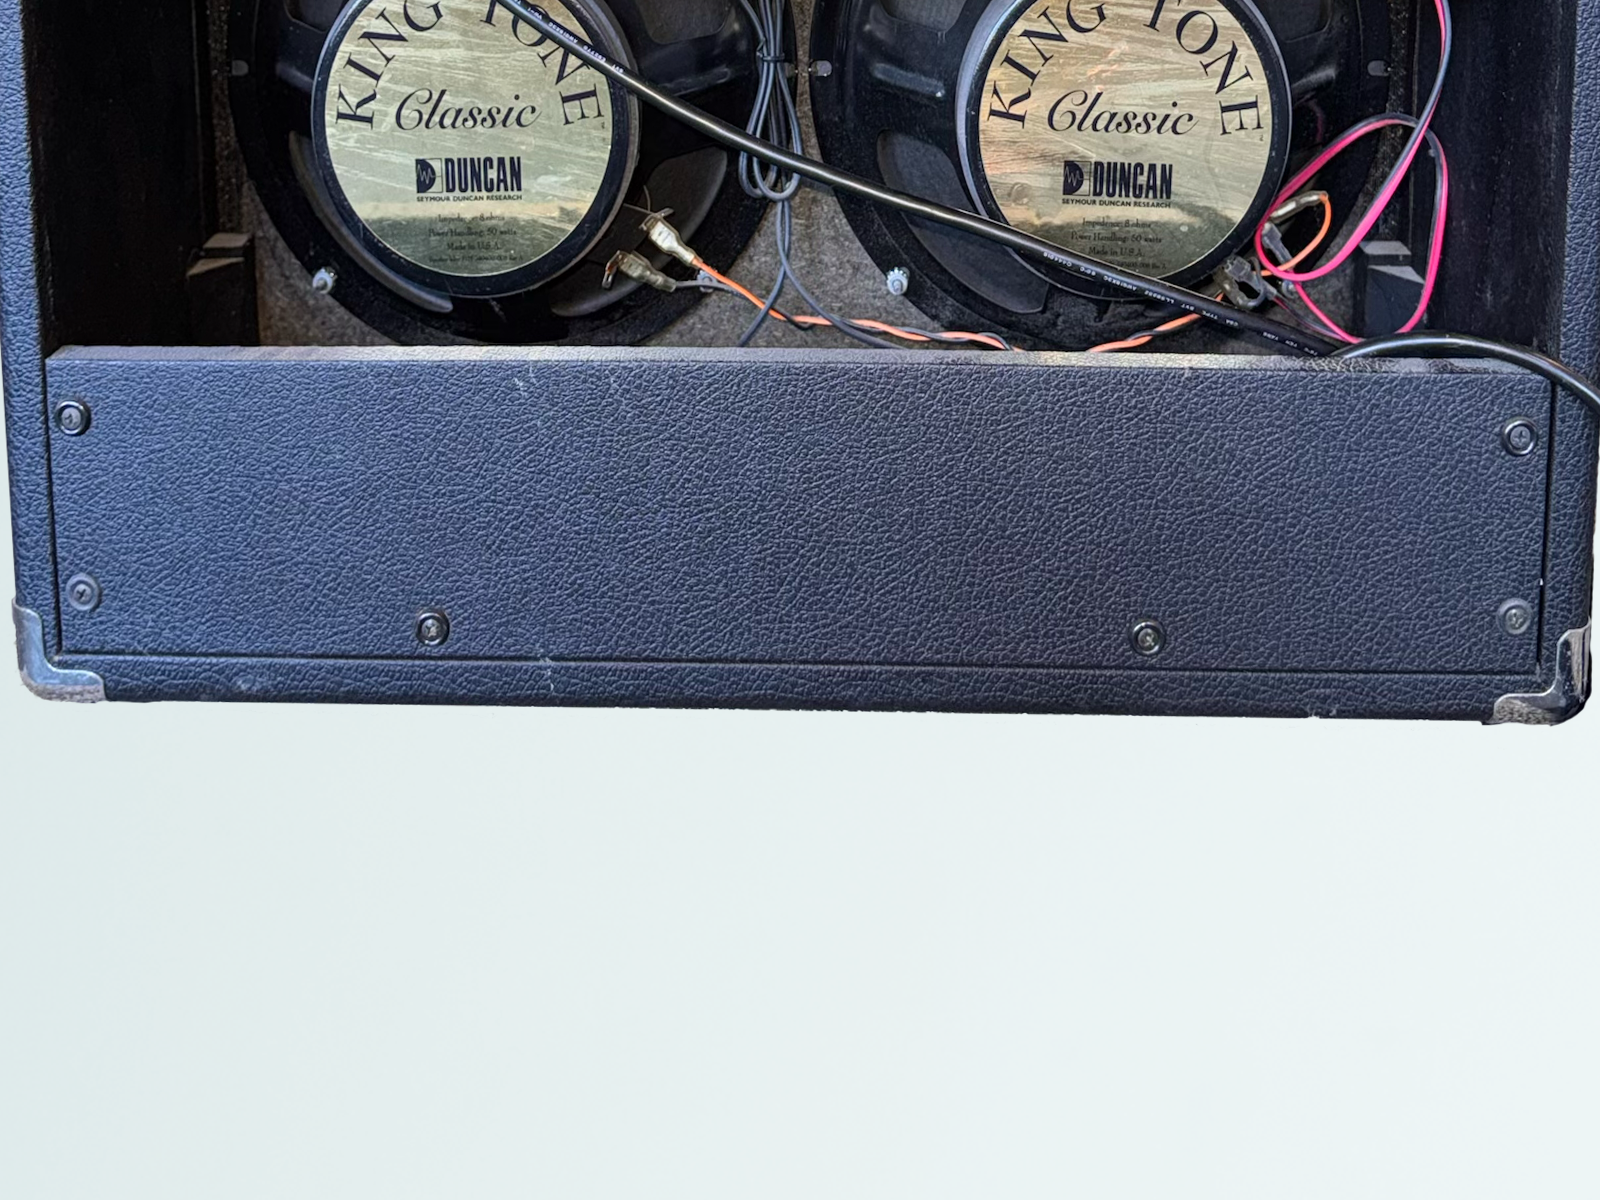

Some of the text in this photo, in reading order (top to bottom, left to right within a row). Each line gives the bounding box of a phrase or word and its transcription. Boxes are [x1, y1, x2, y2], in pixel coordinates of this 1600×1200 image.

[395, 88, 542, 131] Classic
[1047, 89, 1198, 135] Classic
[444, 156, 522, 193] DUNCAN
[1092, 161, 1173, 199] DUNCAN
[1062, 198, 1096, 206] SEYMOUR
[1099, 199, 1131, 207] DUNCAN
[1089, 246, 1108, 255] Made
[1110, 247, 1117, 256] in
